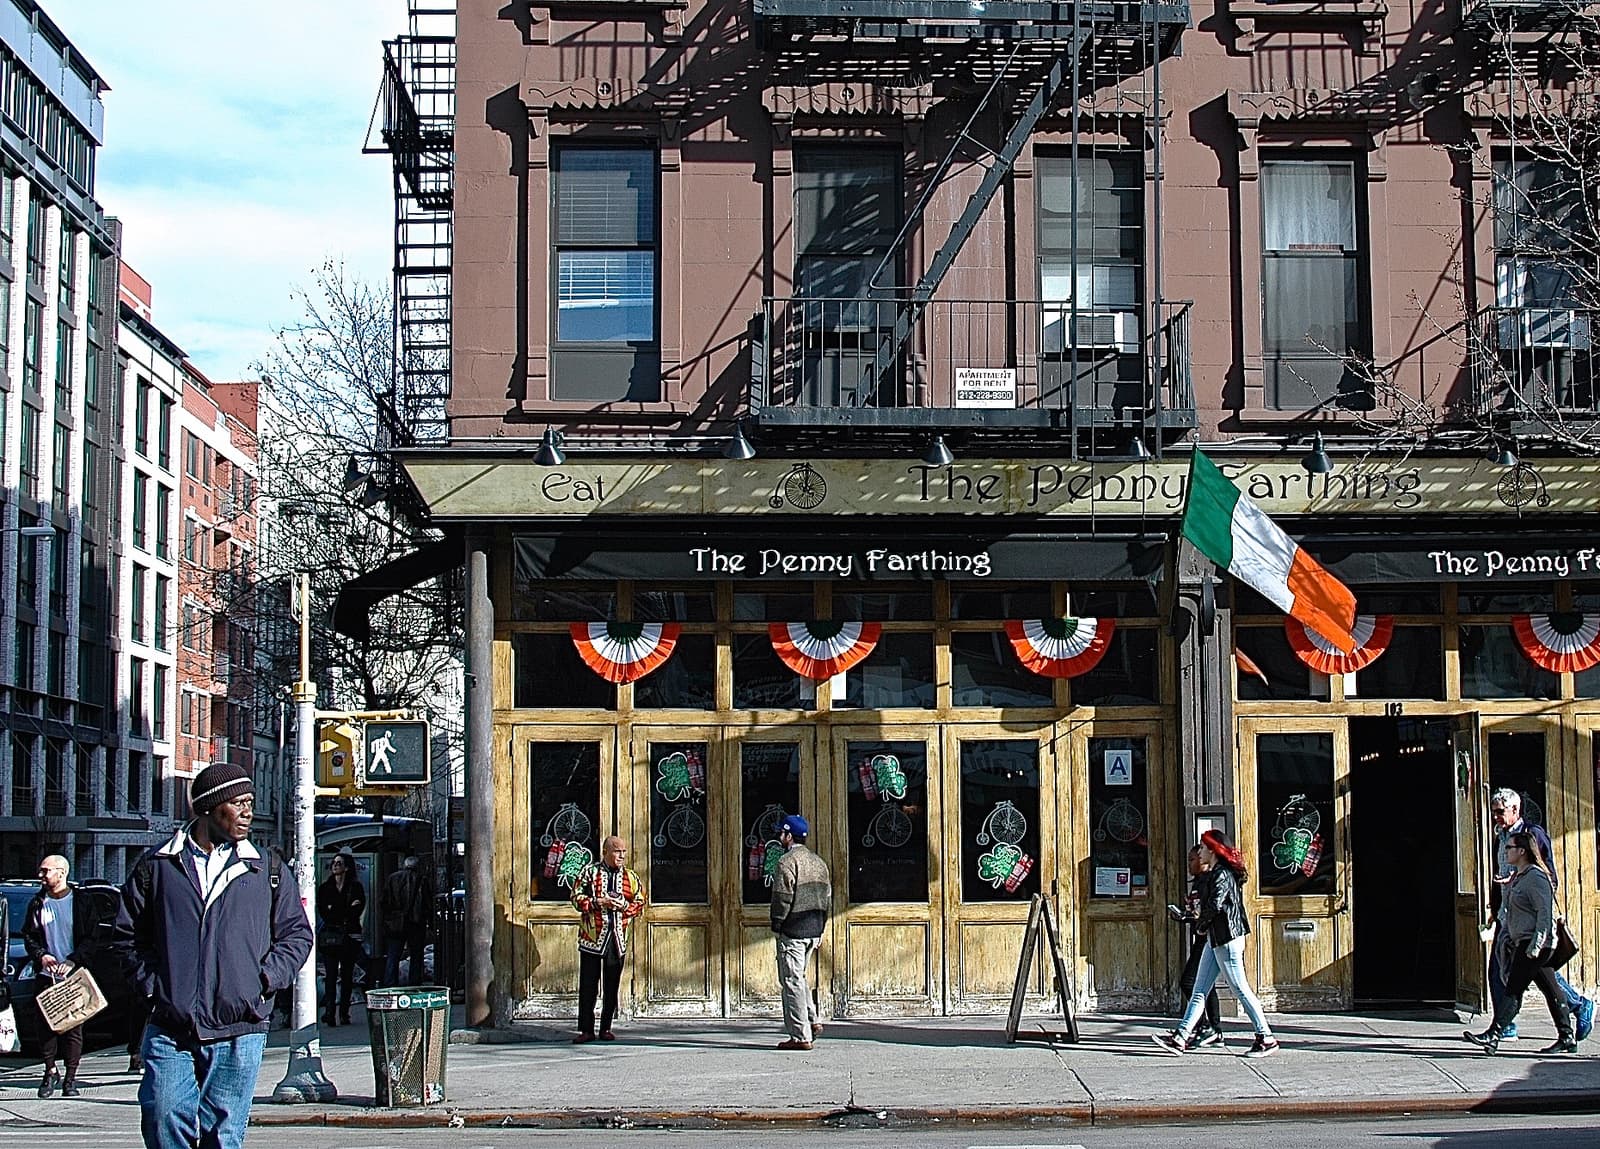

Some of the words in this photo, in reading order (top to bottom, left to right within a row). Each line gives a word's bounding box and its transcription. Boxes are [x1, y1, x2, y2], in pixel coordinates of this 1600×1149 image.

[958, 371, 1012, 379] APARTMENT
[541, 472, 605, 502] Eat
[907, 464, 1003, 505] The
[1027, 464, 1188, 509] Penny
[688, 547, 746, 573] The
[760, 549, 853, 577] Penny
[866, 548, 992, 577] Farthing
[1427, 550, 1479, 576] The
[1484, 550, 1570, 577] Penny
[1384, 702, 1403, 717] 103
[1109, 756, 1127, 776] A
